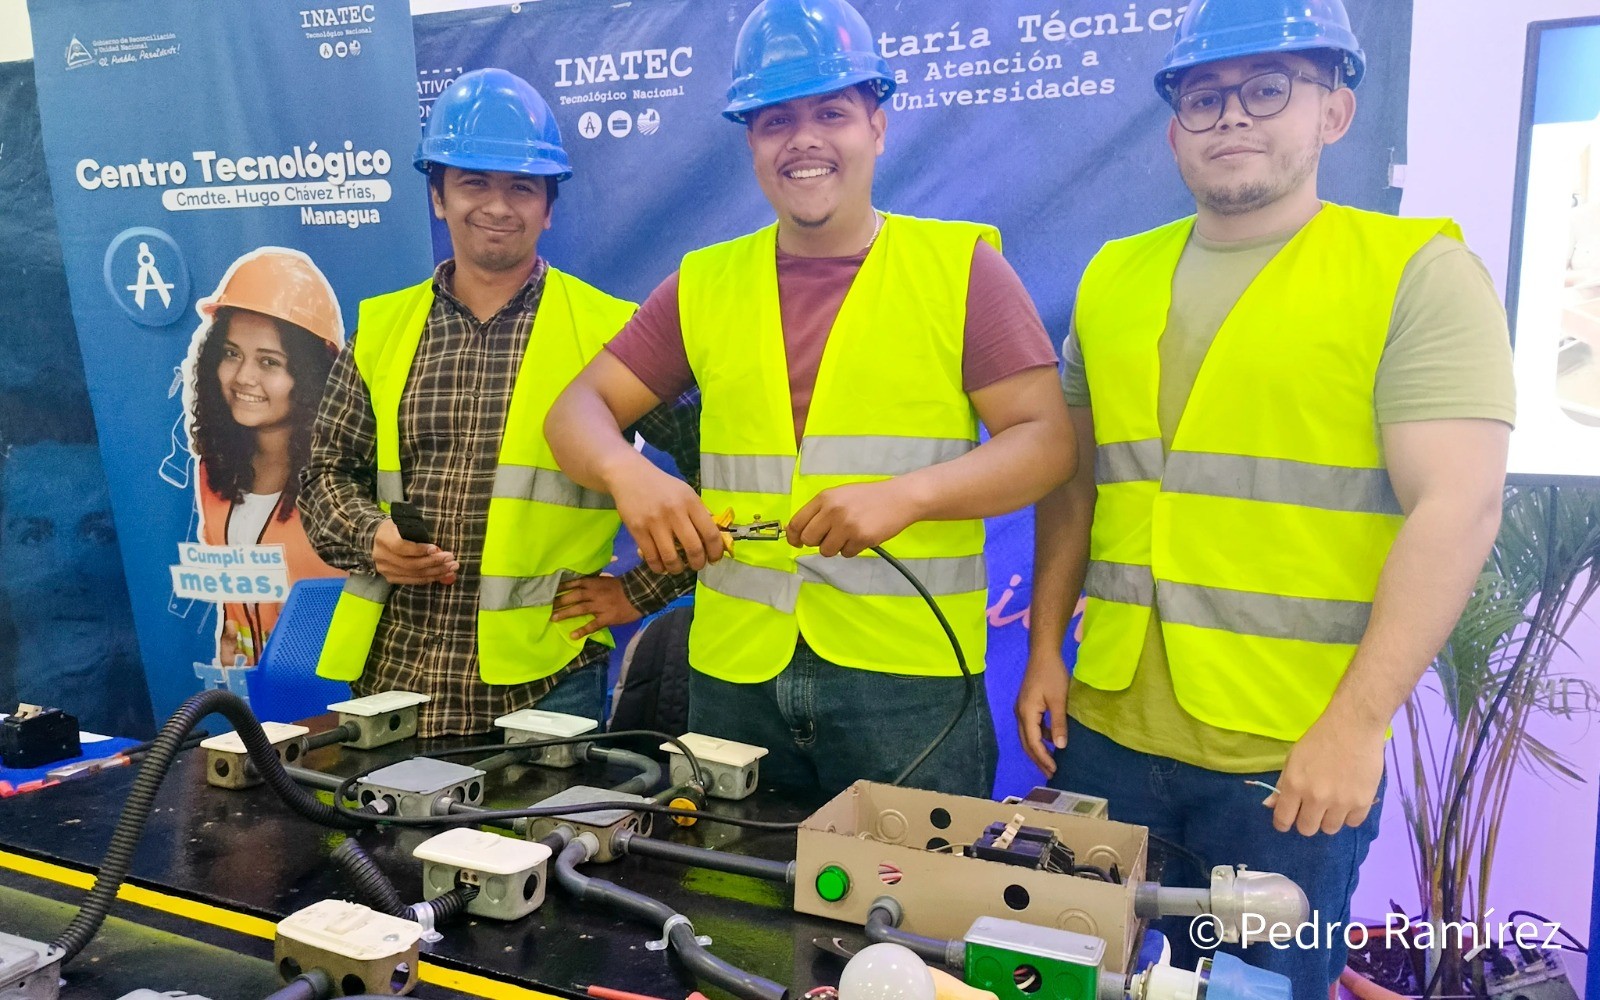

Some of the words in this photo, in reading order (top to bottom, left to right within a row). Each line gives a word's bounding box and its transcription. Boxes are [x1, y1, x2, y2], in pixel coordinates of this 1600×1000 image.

[299, 5, 375, 28] INATEC
[346, 27, 372, 35] Nacional
[877, 21, 991, 58] taría
[120, 43, 148, 51] Nacional
[555, 47, 693, 87] INATEC
[924, 50, 1062, 82] Atención
[1081, 50, 1099, 67] a
[560, 90, 627, 106] Tecnológico
[632, 86, 685, 100] Nacional
[892, 76, 1115, 112] Universidades
[75, 157, 187, 190] Centro
[192, 140, 392, 185] Tecnológico
[176, 190, 231, 208] Cmdte.
[235, 188, 281, 207] Hugo
[284, 184, 333, 202] Chávez
[337, 182, 376, 201] Frías,
[301, 206, 380, 229] Managua
[186, 546, 245, 568] Cumplí
[250, 549, 281, 565] tus
[179, 571, 284, 598] metas,
